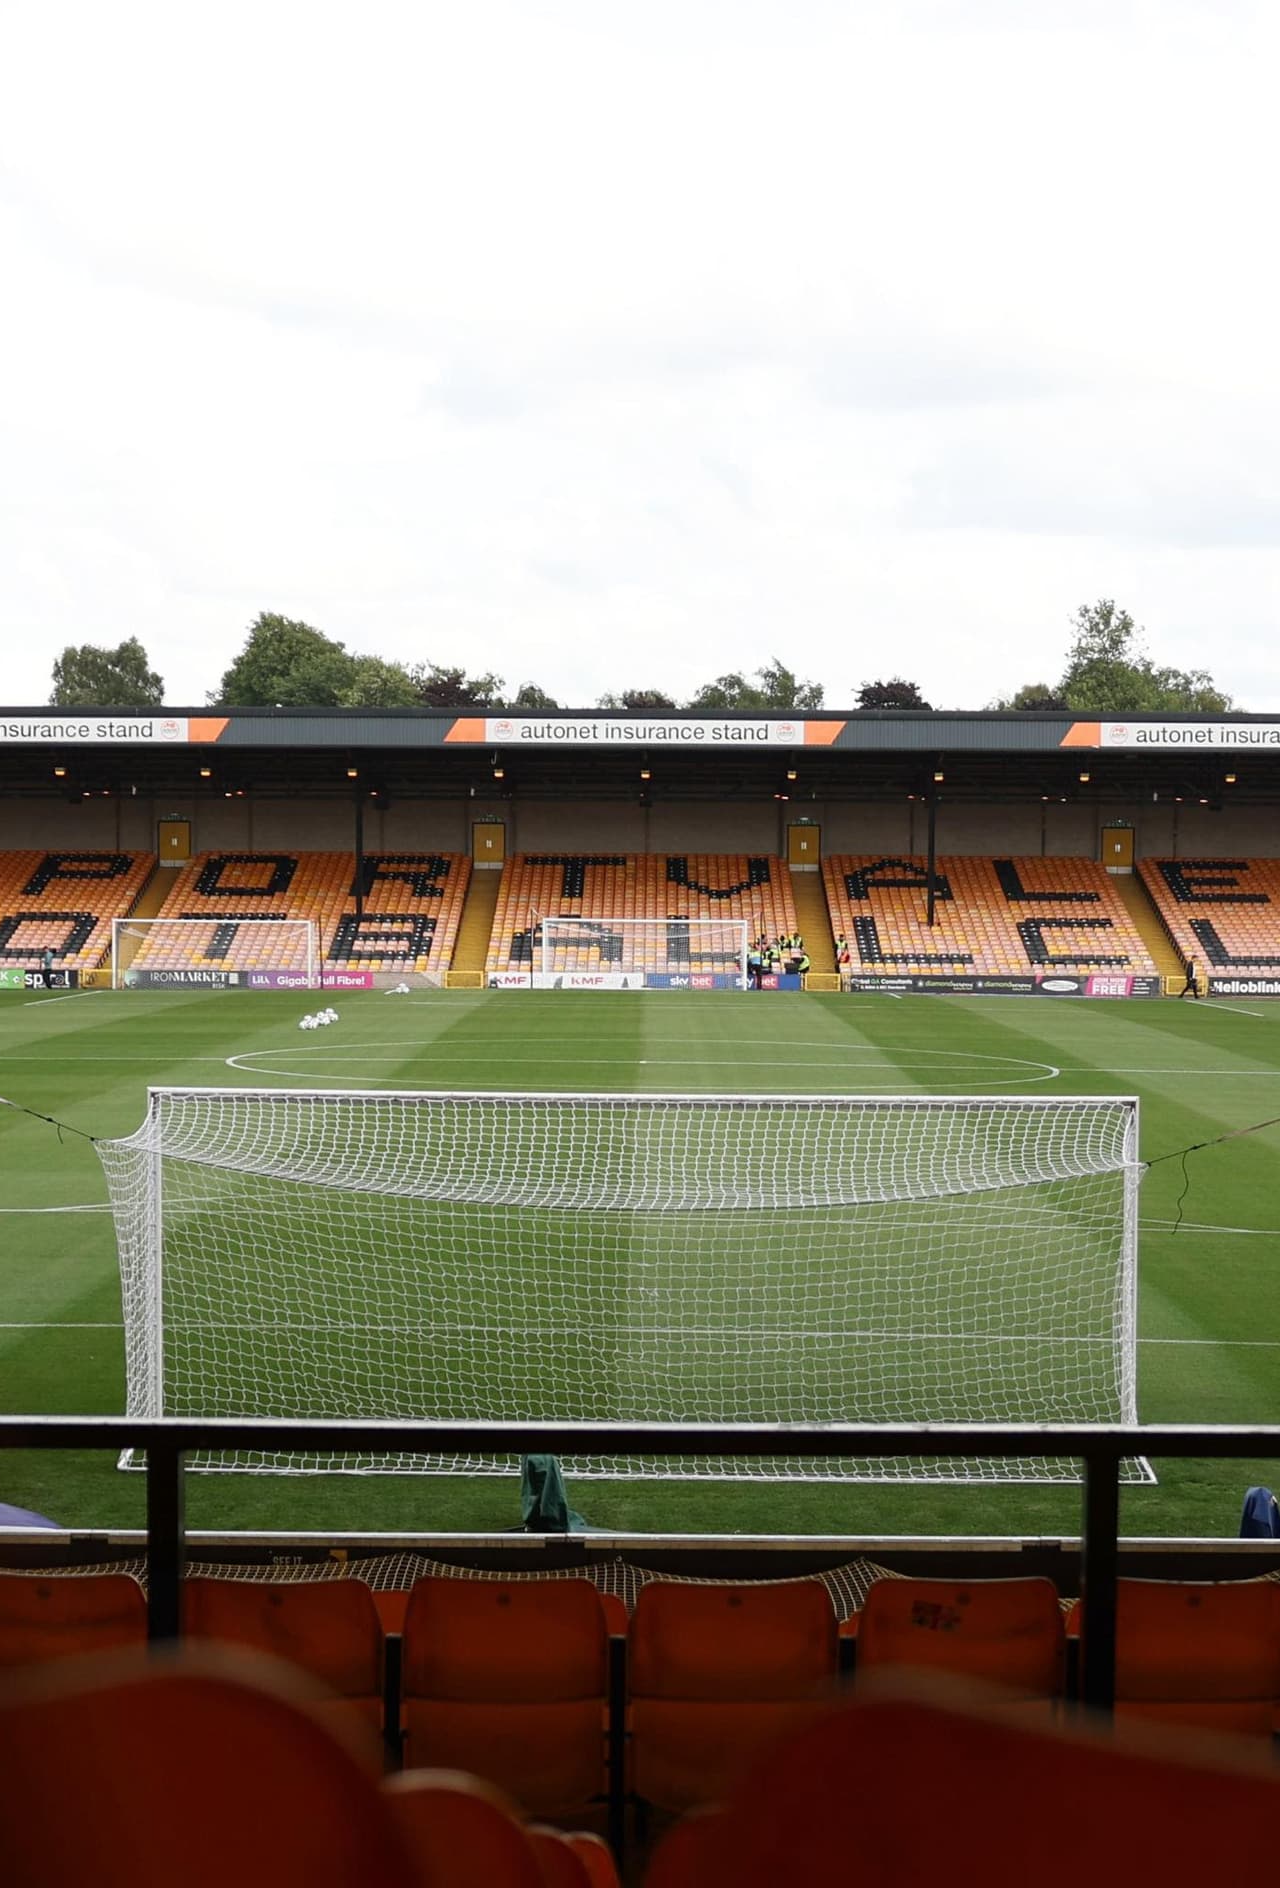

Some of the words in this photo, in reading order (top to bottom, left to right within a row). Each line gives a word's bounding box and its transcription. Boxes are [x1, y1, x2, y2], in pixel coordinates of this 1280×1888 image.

[96, 720, 153, 738] stand
[520, 723, 598, 740] autonet
[604, 723, 705, 740] insurance
[711, 724, 769, 741] stand
[1135, 727, 1213, 743] autonet
[23, 854, 626, 898] PORT
[666, 857, 1271, 903] VALE
[276, 976, 315, 987] Gigabt
[337, 976, 365, 985] Fibre!
[495, 977, 527, 985] KMF
[571, 977, 604, 985] KMF
[669, 975, 689, 987] sky
[691, 975, 712, 986] bet
[736, 976, 754, 988] sy
[1092, 985, 1126, 995] FREE
